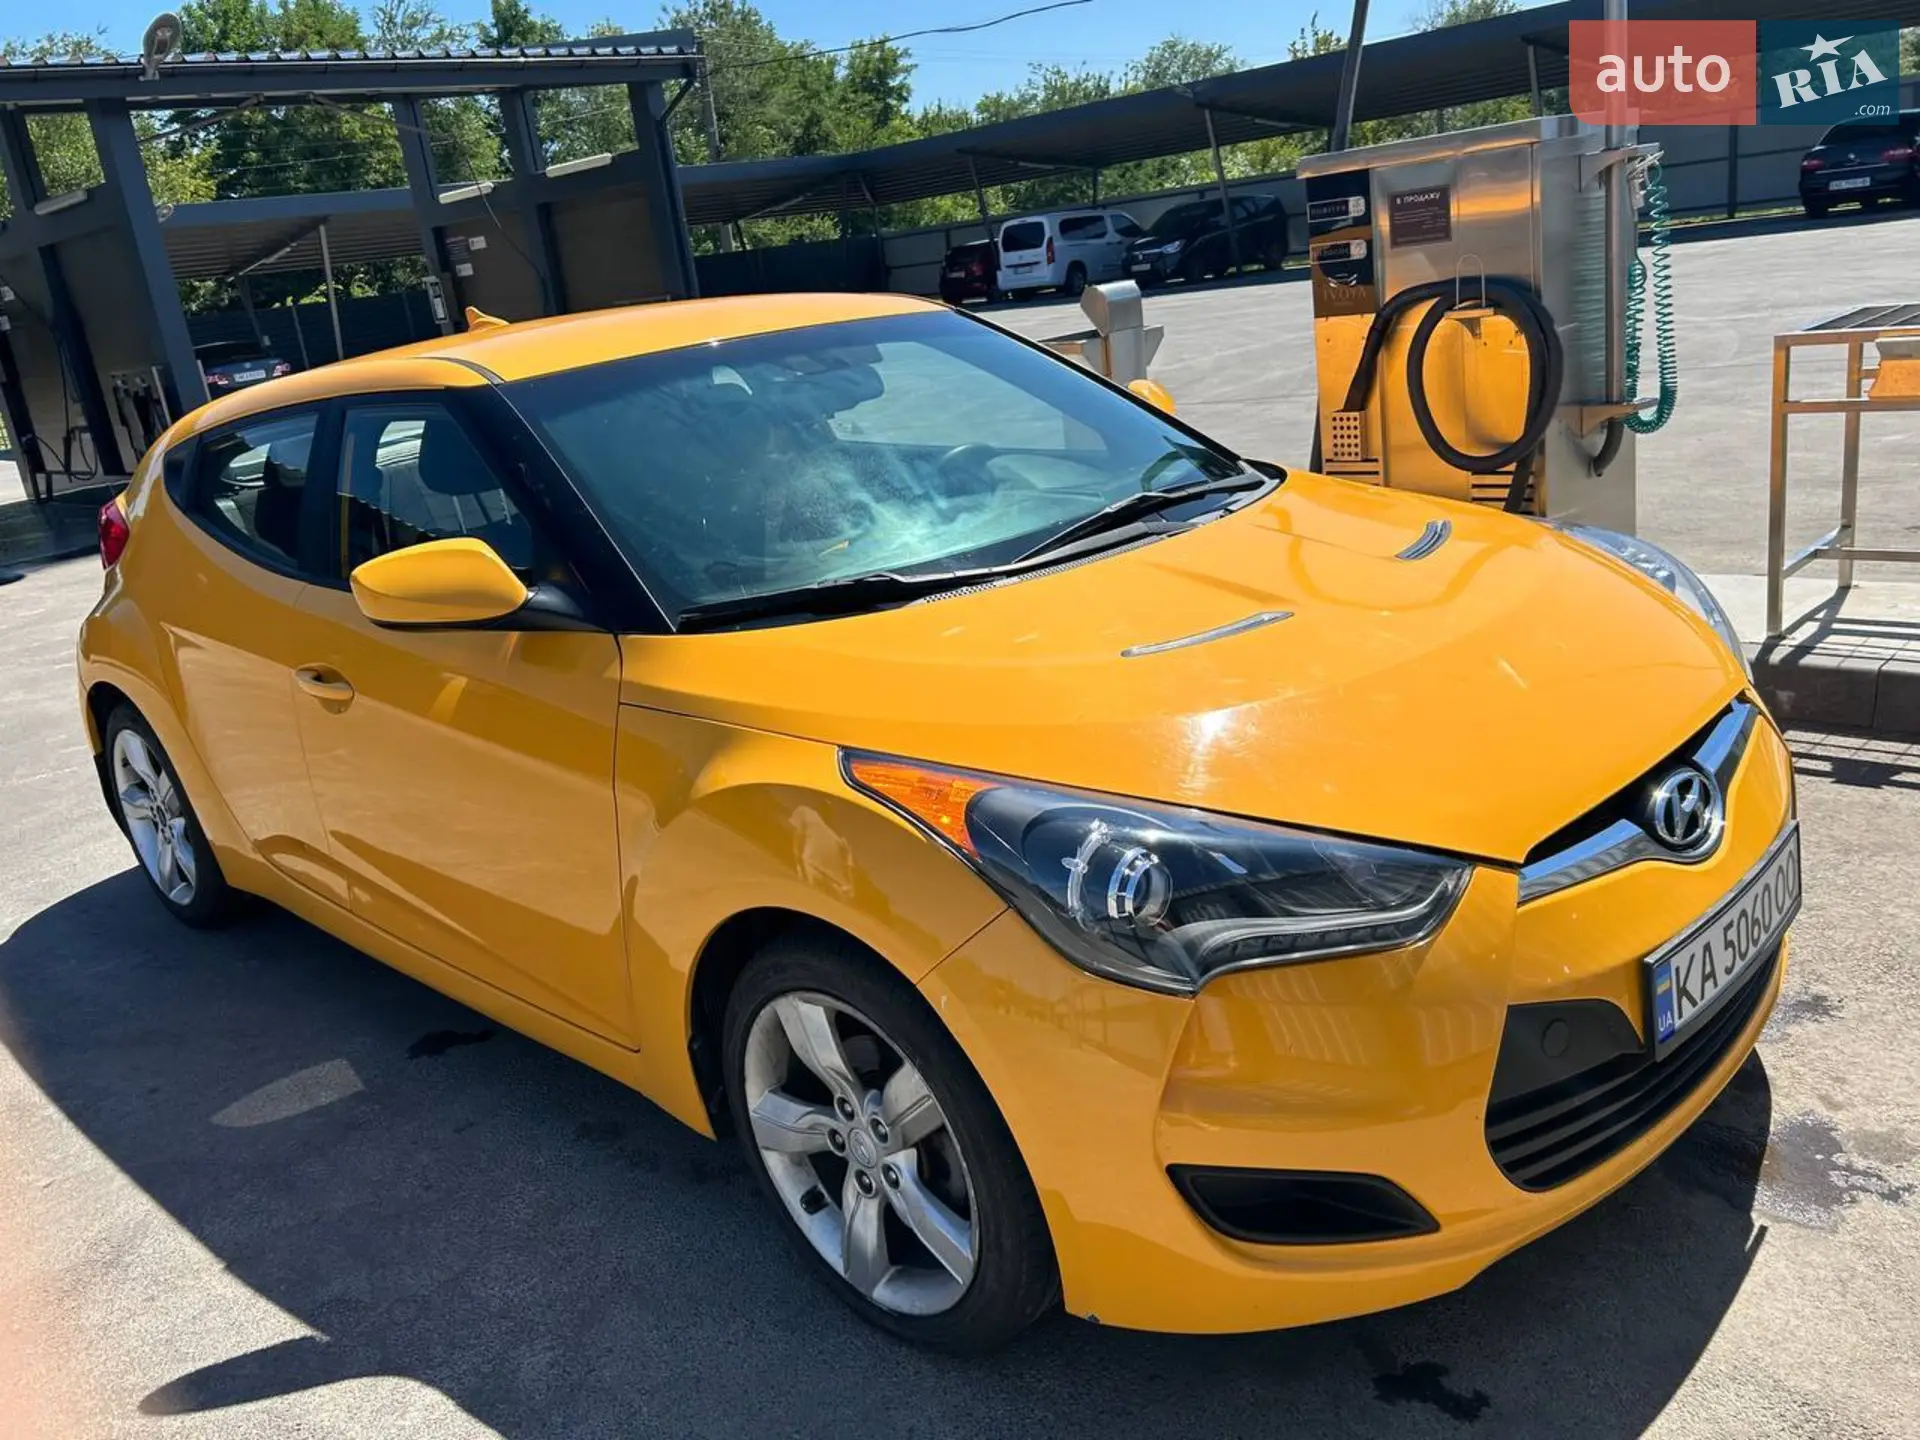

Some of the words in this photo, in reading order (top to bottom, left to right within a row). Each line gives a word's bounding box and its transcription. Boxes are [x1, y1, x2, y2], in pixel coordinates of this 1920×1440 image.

[1675, 941, 1718, 1020] KA
[1723, 882, 1772, 976] 5060
[1658, 1011, 1674, 1033] UA
